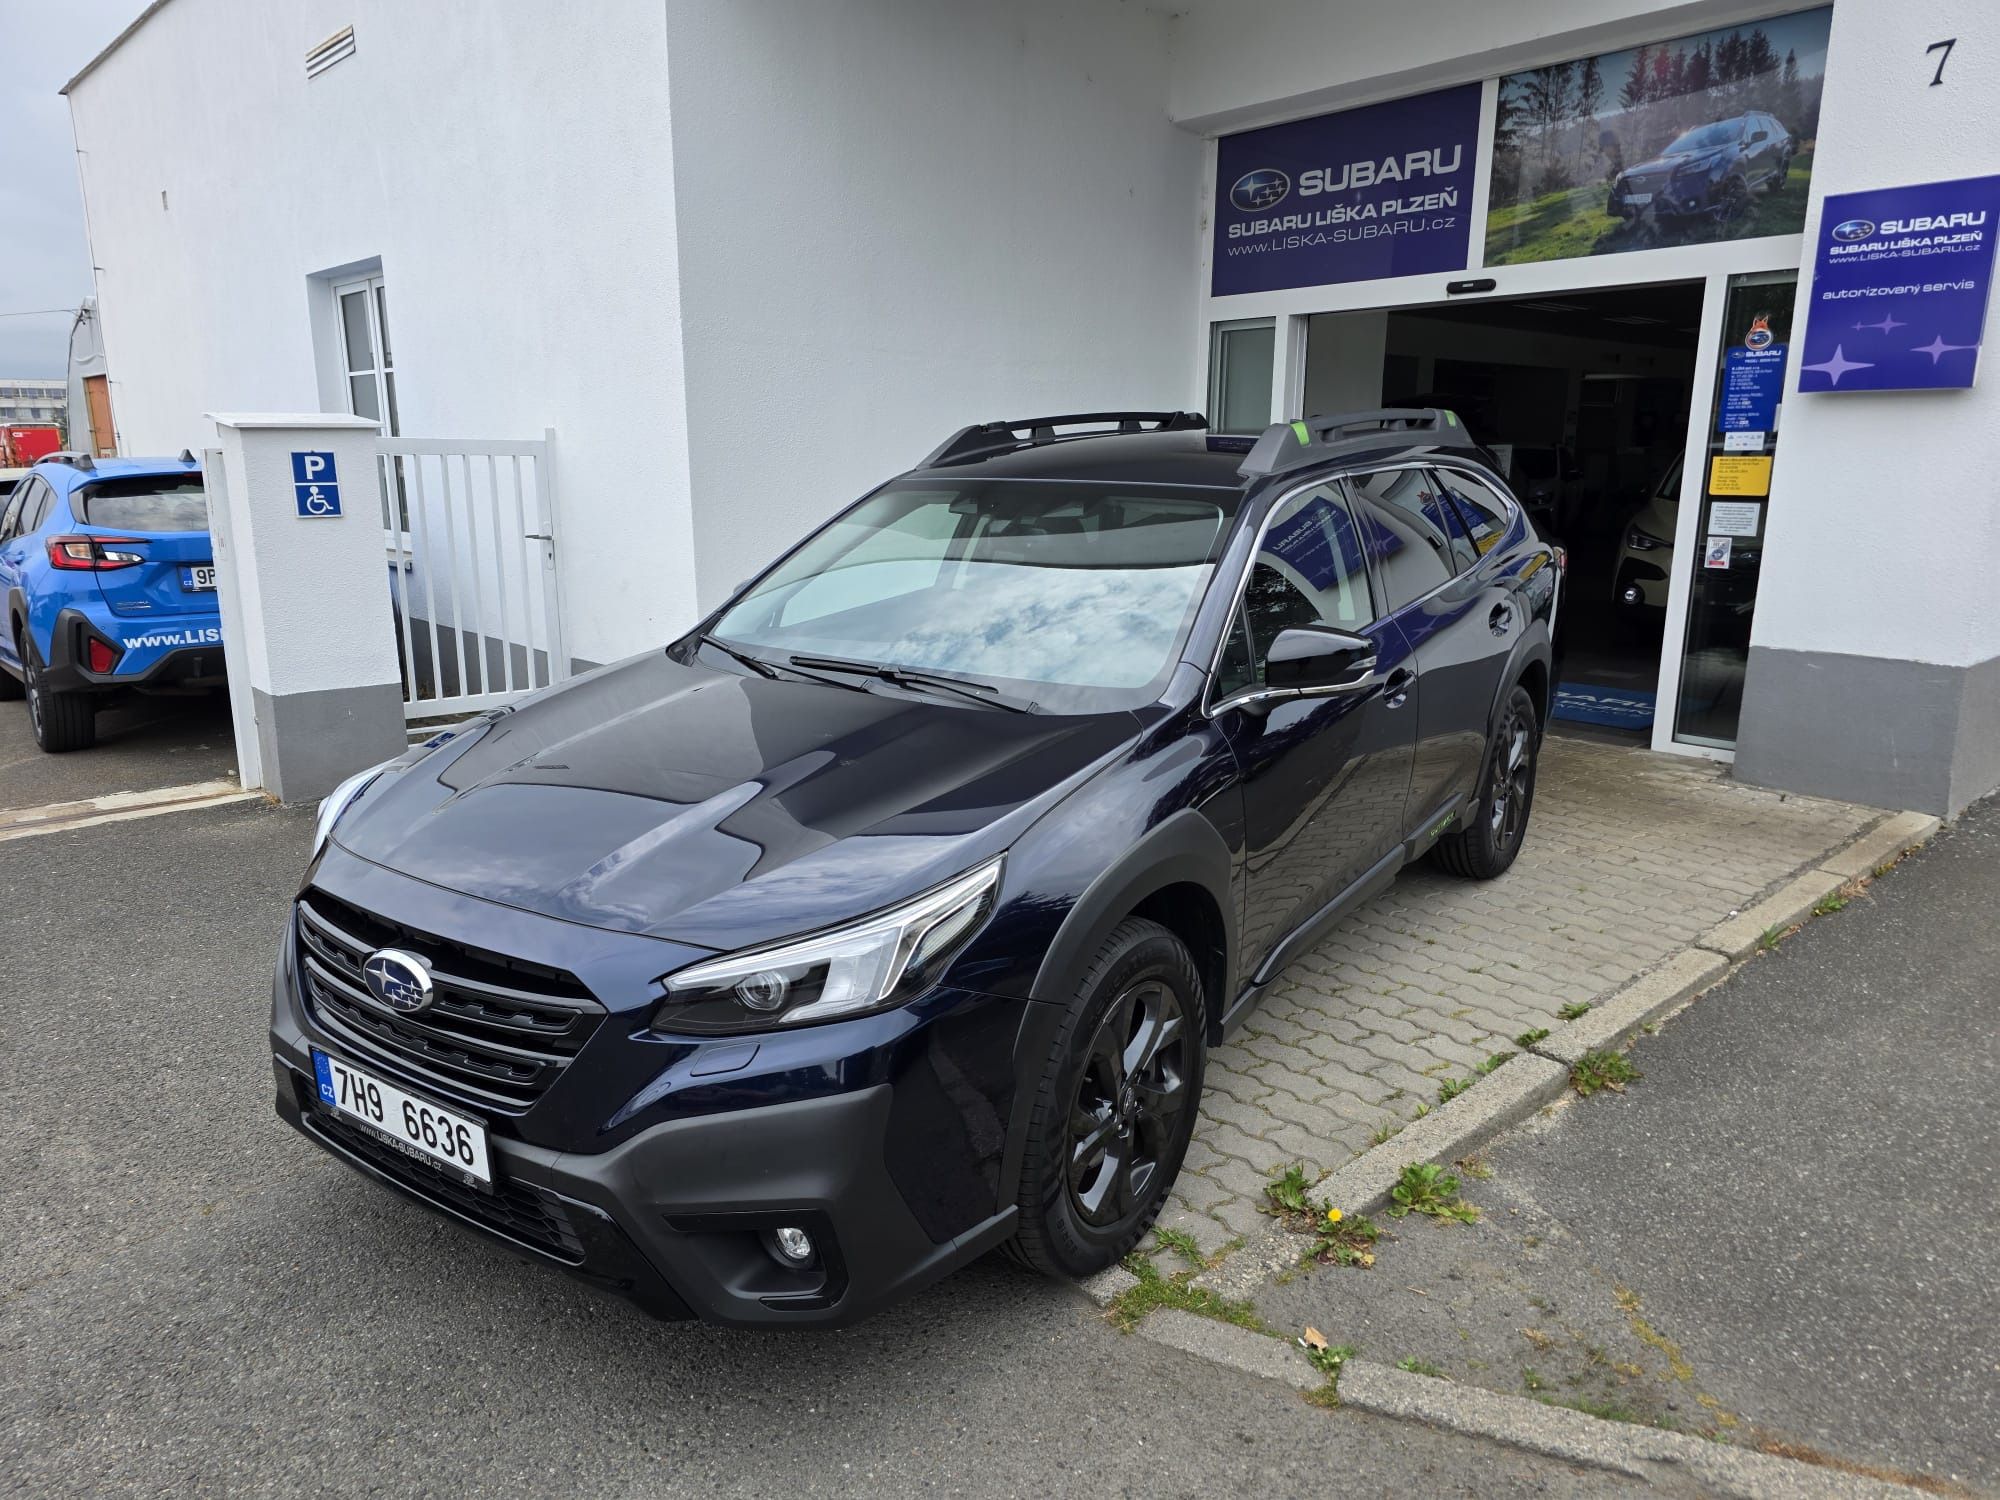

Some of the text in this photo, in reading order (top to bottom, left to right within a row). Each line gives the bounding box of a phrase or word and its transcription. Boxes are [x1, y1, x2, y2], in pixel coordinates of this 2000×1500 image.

[1926, 38, 1957, 87] 7
[1298, 144, 1462, 197] SUBARU
[1228, 186, 1458, 239] SUBARU LIŠKA PLZEŇ
[1879, 210, 1987, 235] SUBARU
[1227, 217, 1456, 257] www.LISKA-SUBARU.cz
[1829, 230, 1983, 255] SUBARU LIŠKA PLZEŇ
[1822, 279, 1976, 300] autorizovaný servis
[1745, 349, 1782, 358] SUBARU
[304, 455, 326, 480] P
[196, 568, 216, 585] 9P
[122, 628, 223, 649] www.LIS
[321, 1065, 474, 1166] CZ 7H9 6636
